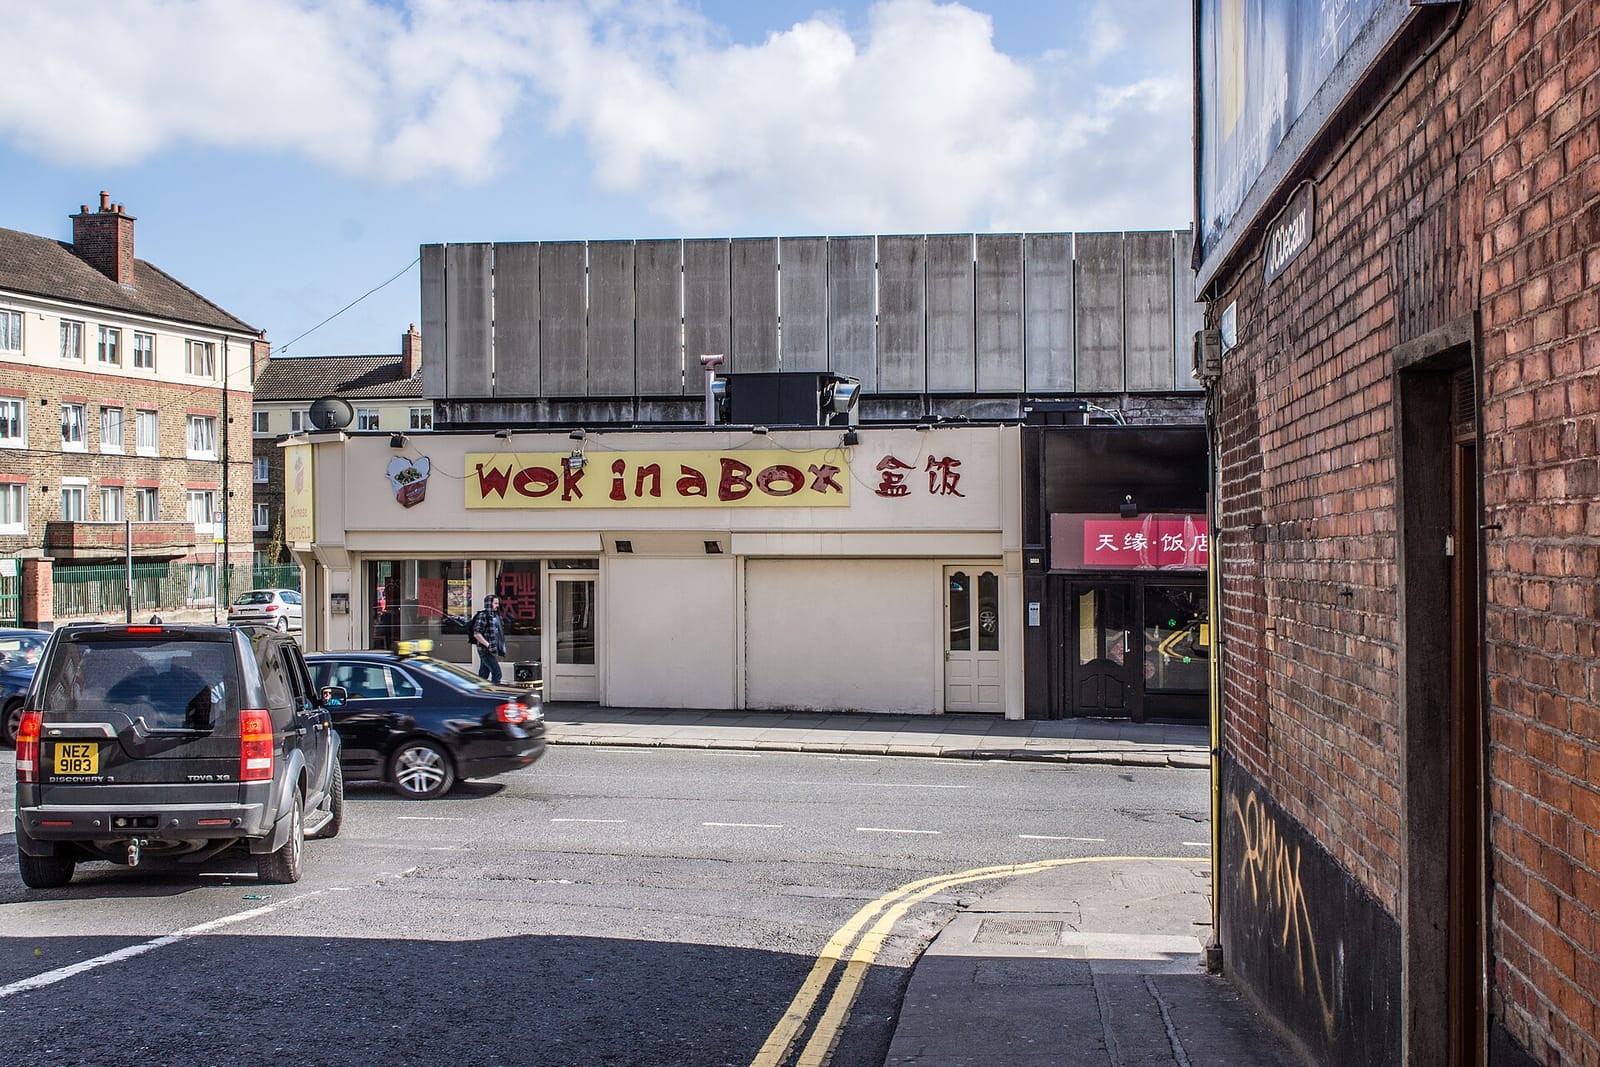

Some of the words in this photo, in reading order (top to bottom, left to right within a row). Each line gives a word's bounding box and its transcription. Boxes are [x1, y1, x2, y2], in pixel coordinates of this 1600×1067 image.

[1269, 207, 1307, 275] JCDecaux
[874, 454, 966, 498] 盒饭
[500, 572, 537, 596] 开业
[501, 596, 537, 620] 大吉
[62, 745, 90, 758] NEZ
[60, 759, 92, 772] 9183
